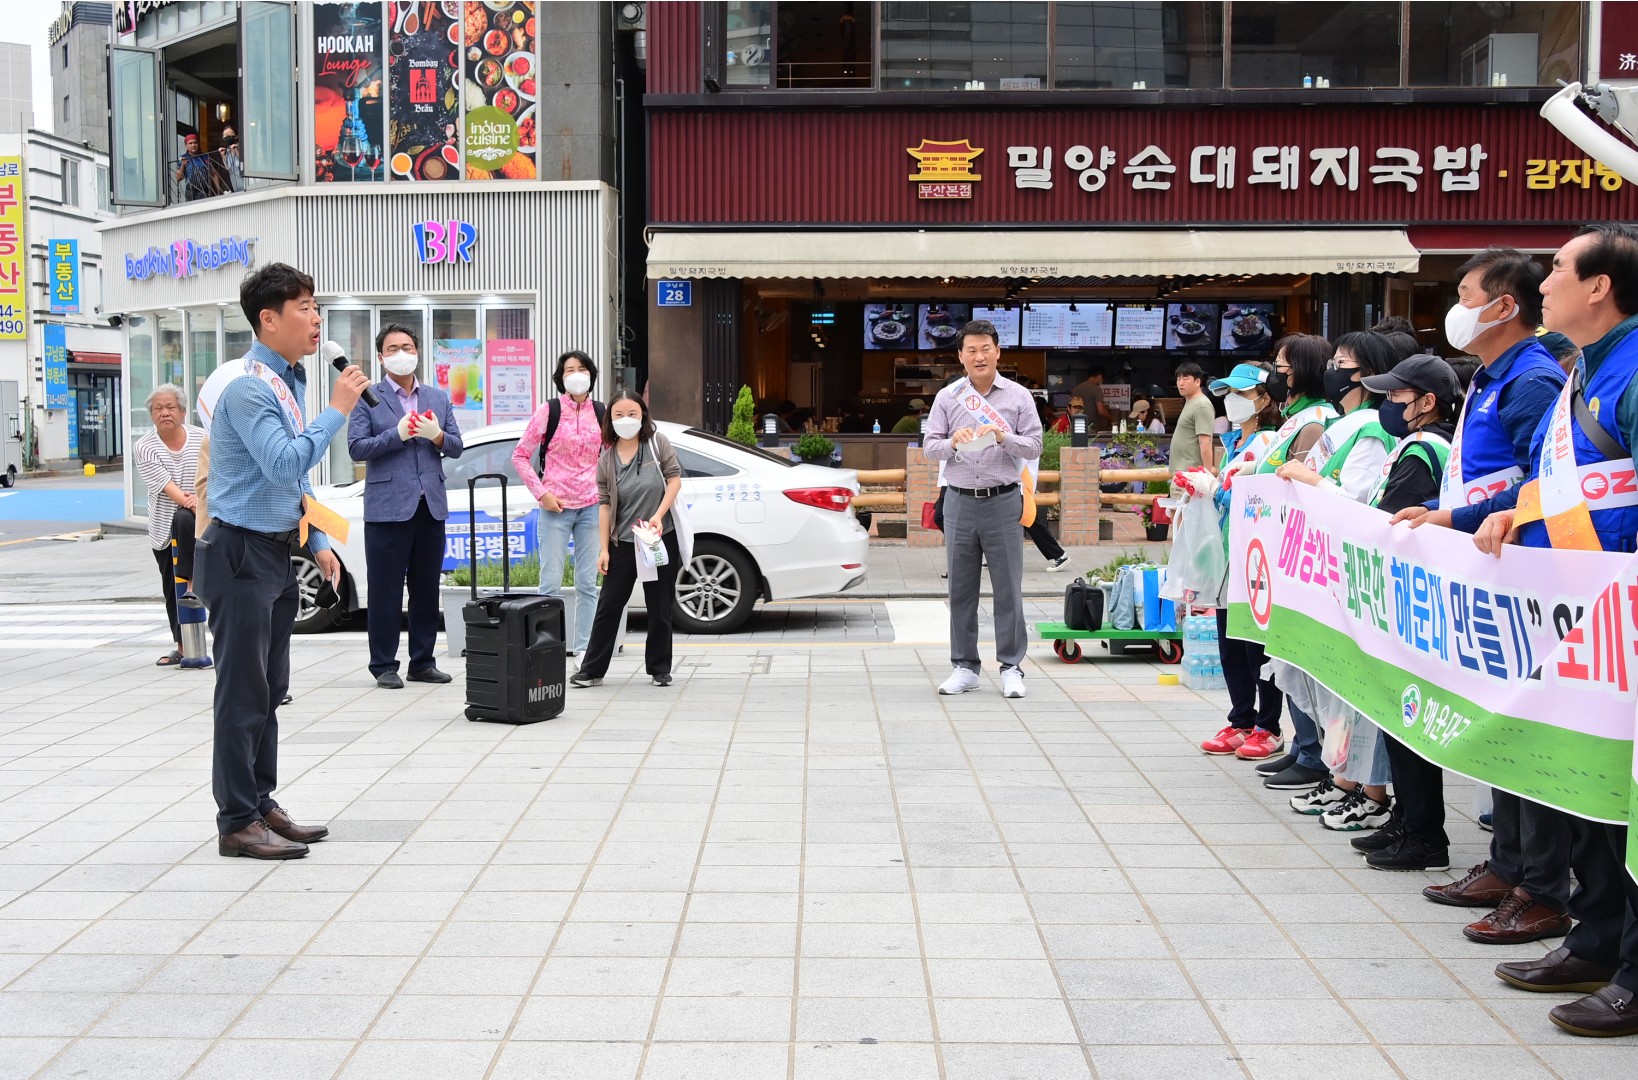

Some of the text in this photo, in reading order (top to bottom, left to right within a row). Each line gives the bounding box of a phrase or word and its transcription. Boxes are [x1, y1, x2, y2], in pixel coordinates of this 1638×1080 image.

[317, 35, 374, 54] HOOKAH
[318, 48, 372, 88] Lounge
[408, 59, 438, 68] Bombay
[1619, 53, 1638, 70] 济
[413, 104, 434, 113] Bräu
[470, 120, 511, 135] indian
[466, 135, 511, 146] cuisine
[919, 184, 971, 197] 부산본점
[412, 218, 479, 264] BR
[125, 251, 169, 280] baskin
[196, 236, 250, 270] robbins
[54, 242, 75, 300] 부동산
[669, 267, 727, 276] 밀양돼지국밥
[1000, 266, 1058, 275] 밀양돼지국밥
[1336, 262, 1396, 271] 밀양돼지국밥
[665, 290, 684, 301] 28
[46, 345, 65, 362] 구남로
[47, 368, 66, 385] 부동산
[1102, 387, 1129, 398] 프코너
[715, 491, 761, 502] 5423
[1342, 541, 1390, 635] 쾌적한
[1390, 556, 1450, 662] 해운대
[1423, 697, 1472, 748] 해운대구
